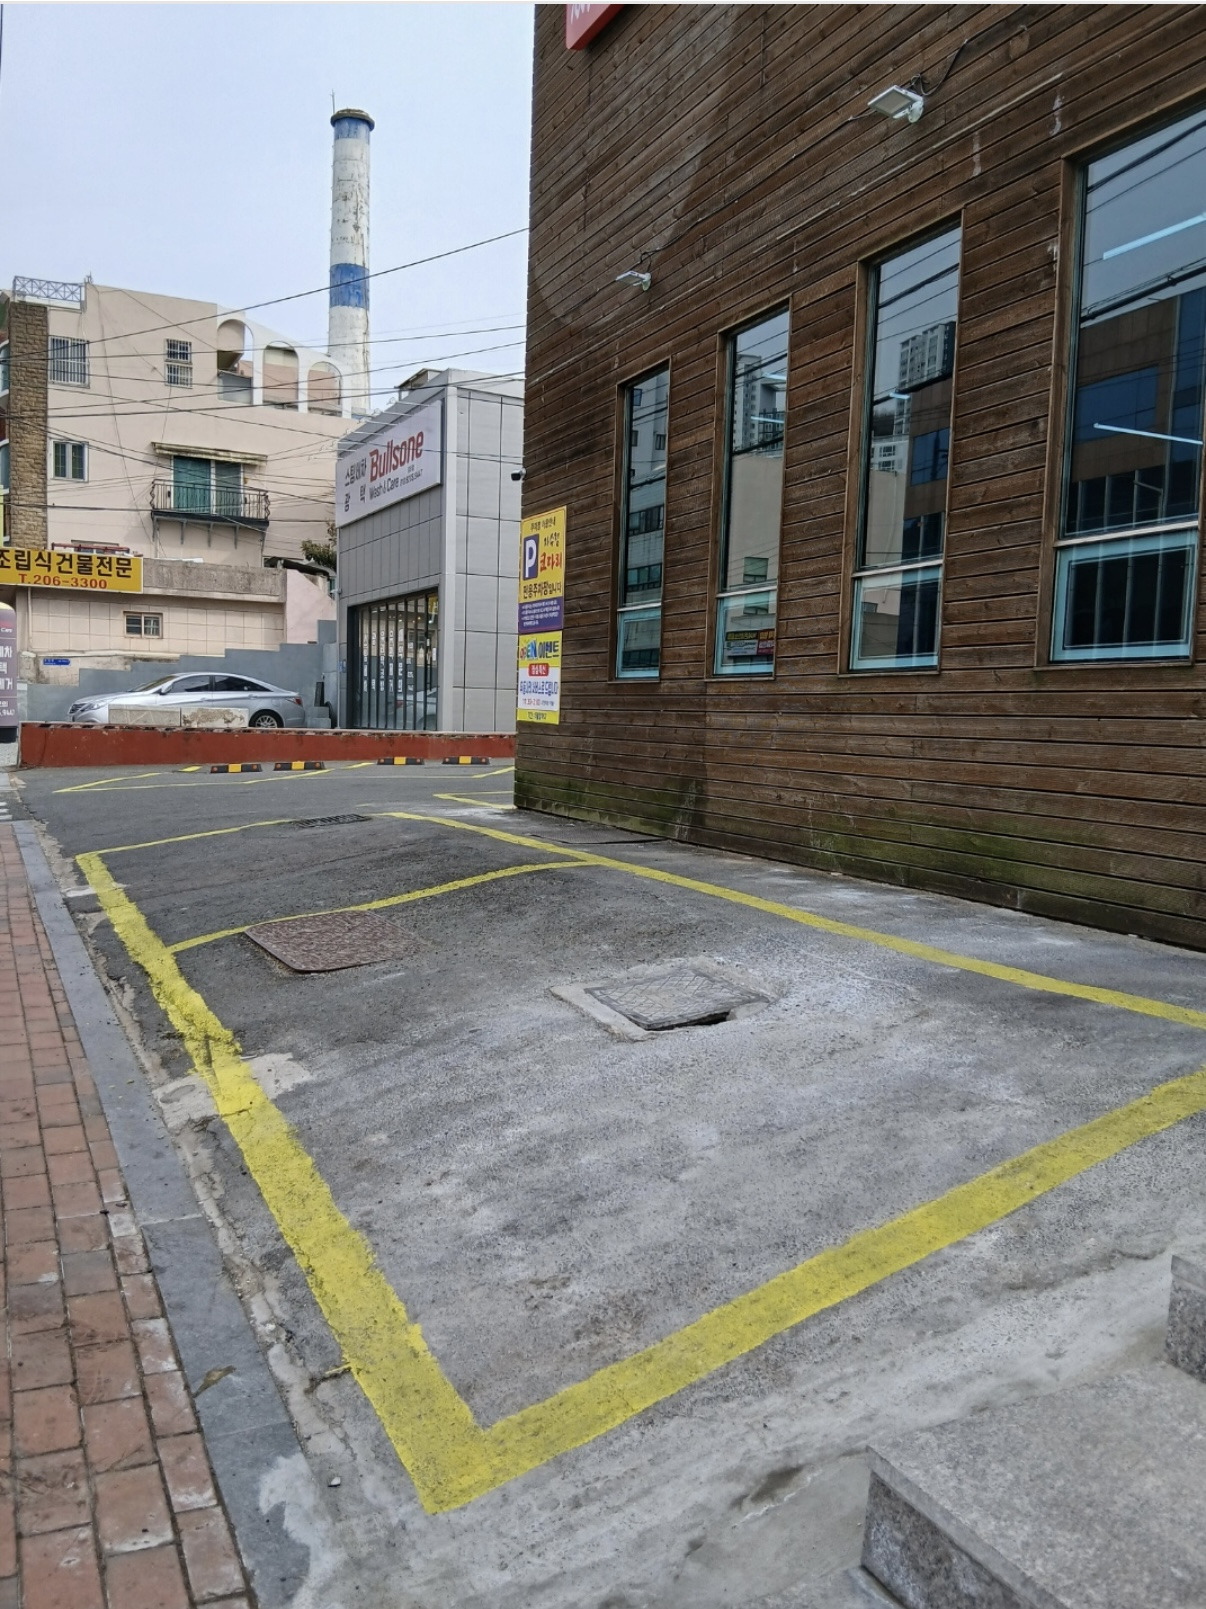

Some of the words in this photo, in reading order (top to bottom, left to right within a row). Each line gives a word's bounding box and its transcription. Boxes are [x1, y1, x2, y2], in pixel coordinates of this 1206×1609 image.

[369, 431, 424, 483] Bullsone
[345, 457, 367, 488] 스팀세차
[344, 492, 351, 512] 광
[360, 484, 367, 503] 택
[369, 483, 383, 500] Wash
[386, 477, 400, 492] Care
[0, 549, 132, 578] 조립식건물전문
[525, 538, 537, 578] P
[540, 551, 562, 572] 코다리
[18, 573, 108, 589] T.206-3300
[519, 640, 537, 660] OPEN
[538, 641, 559, 658] 이벤트
